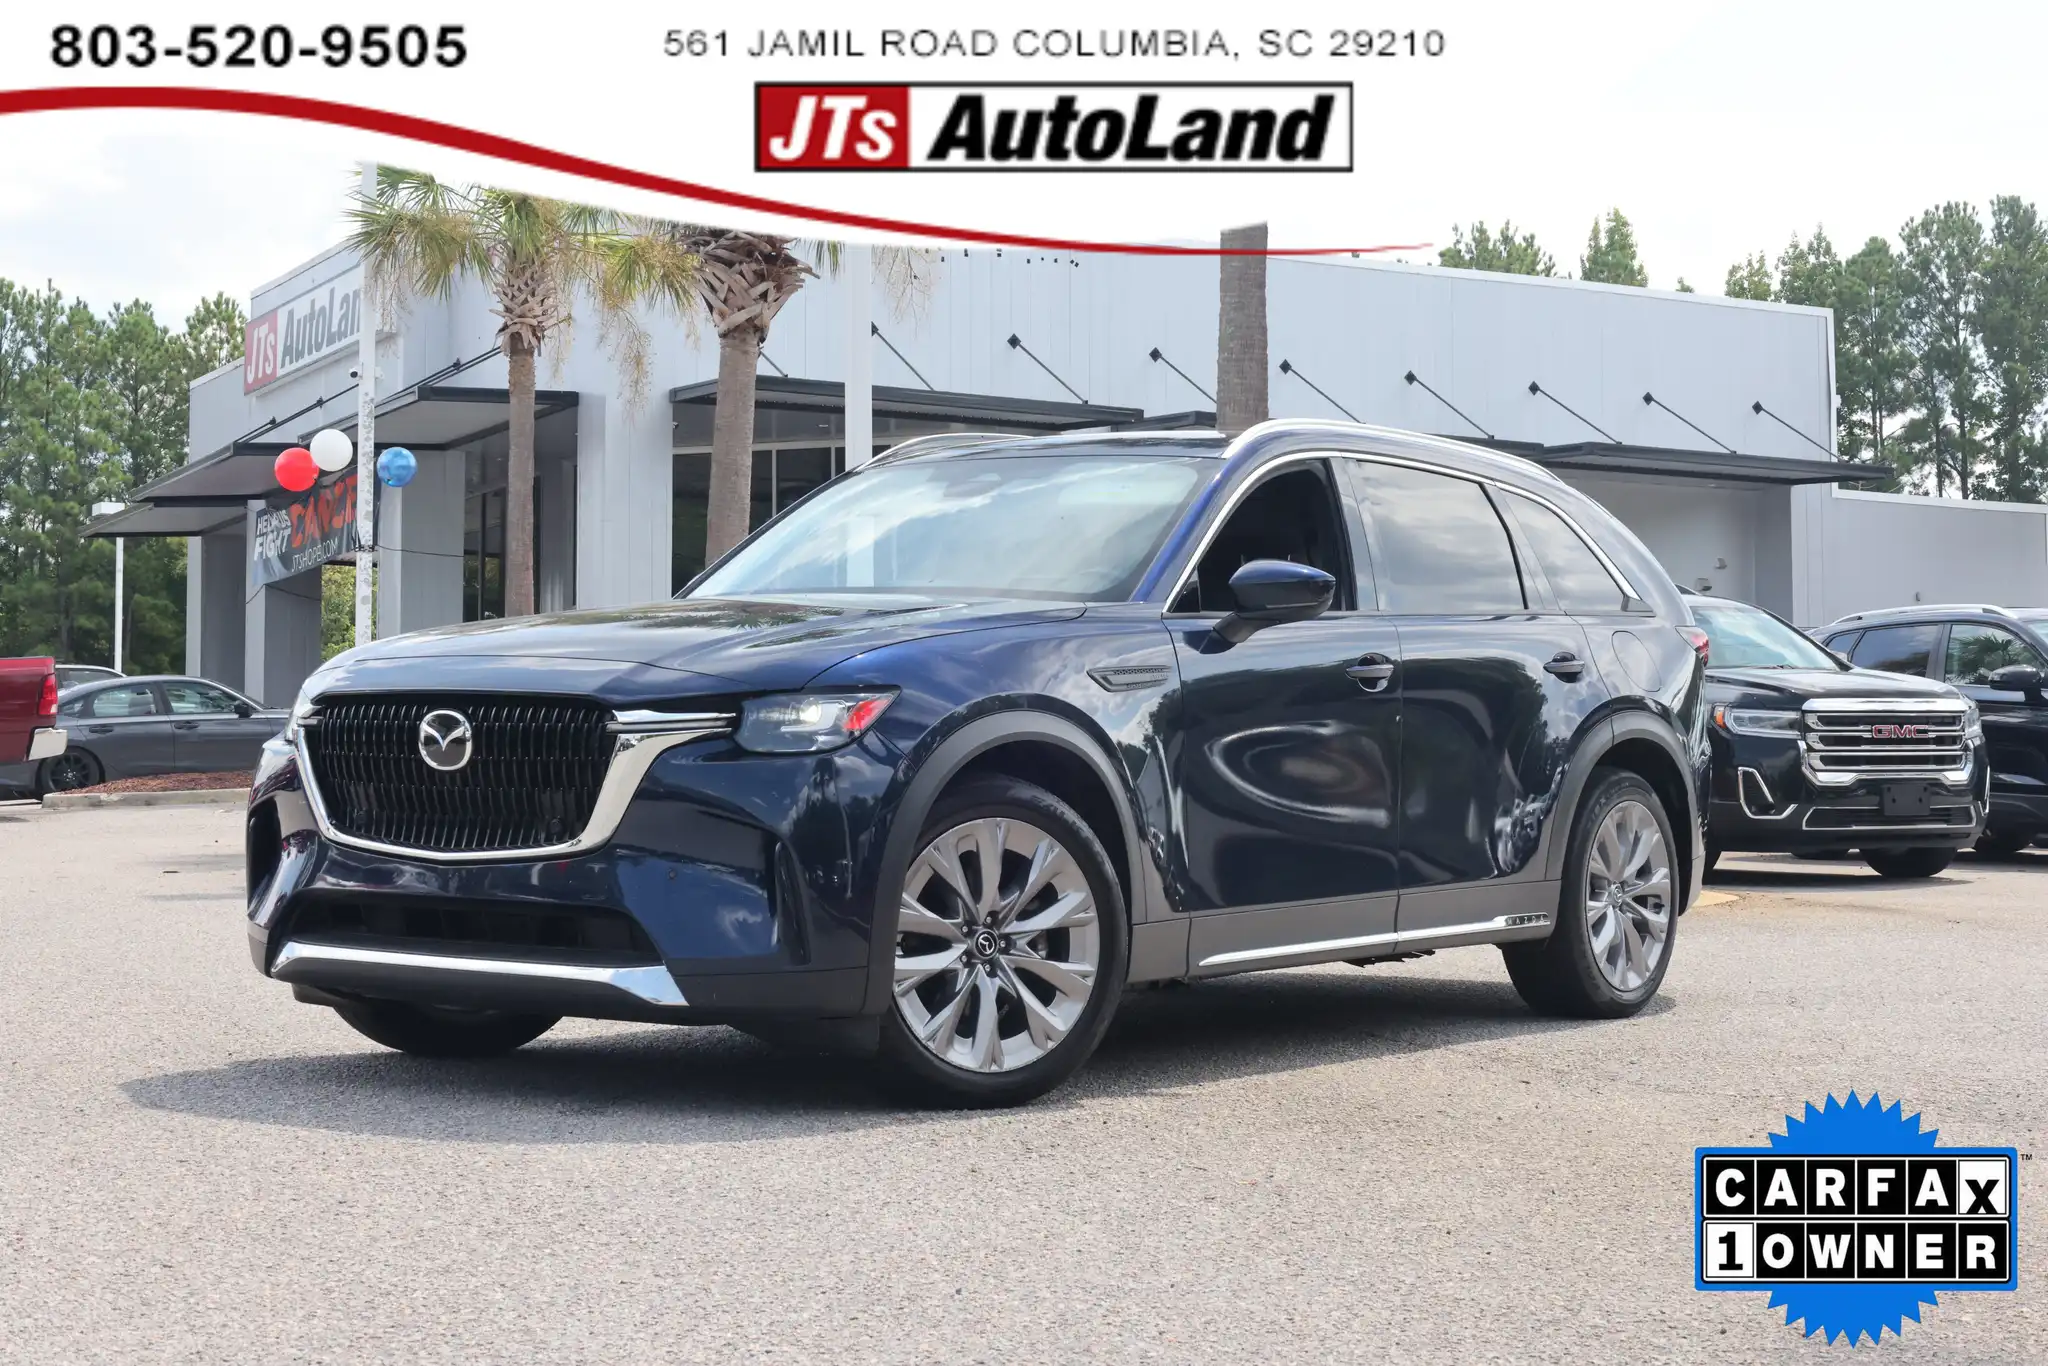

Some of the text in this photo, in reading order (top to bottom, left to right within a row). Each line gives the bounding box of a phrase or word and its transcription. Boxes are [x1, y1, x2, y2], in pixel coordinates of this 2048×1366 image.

[247, 286, 361, 384] JTs AutoLan
[290, 474, 358, 548] CANCE
[254, 527, 292, 561] FIGHT
[1872, 725, 1929, 738] GMC
